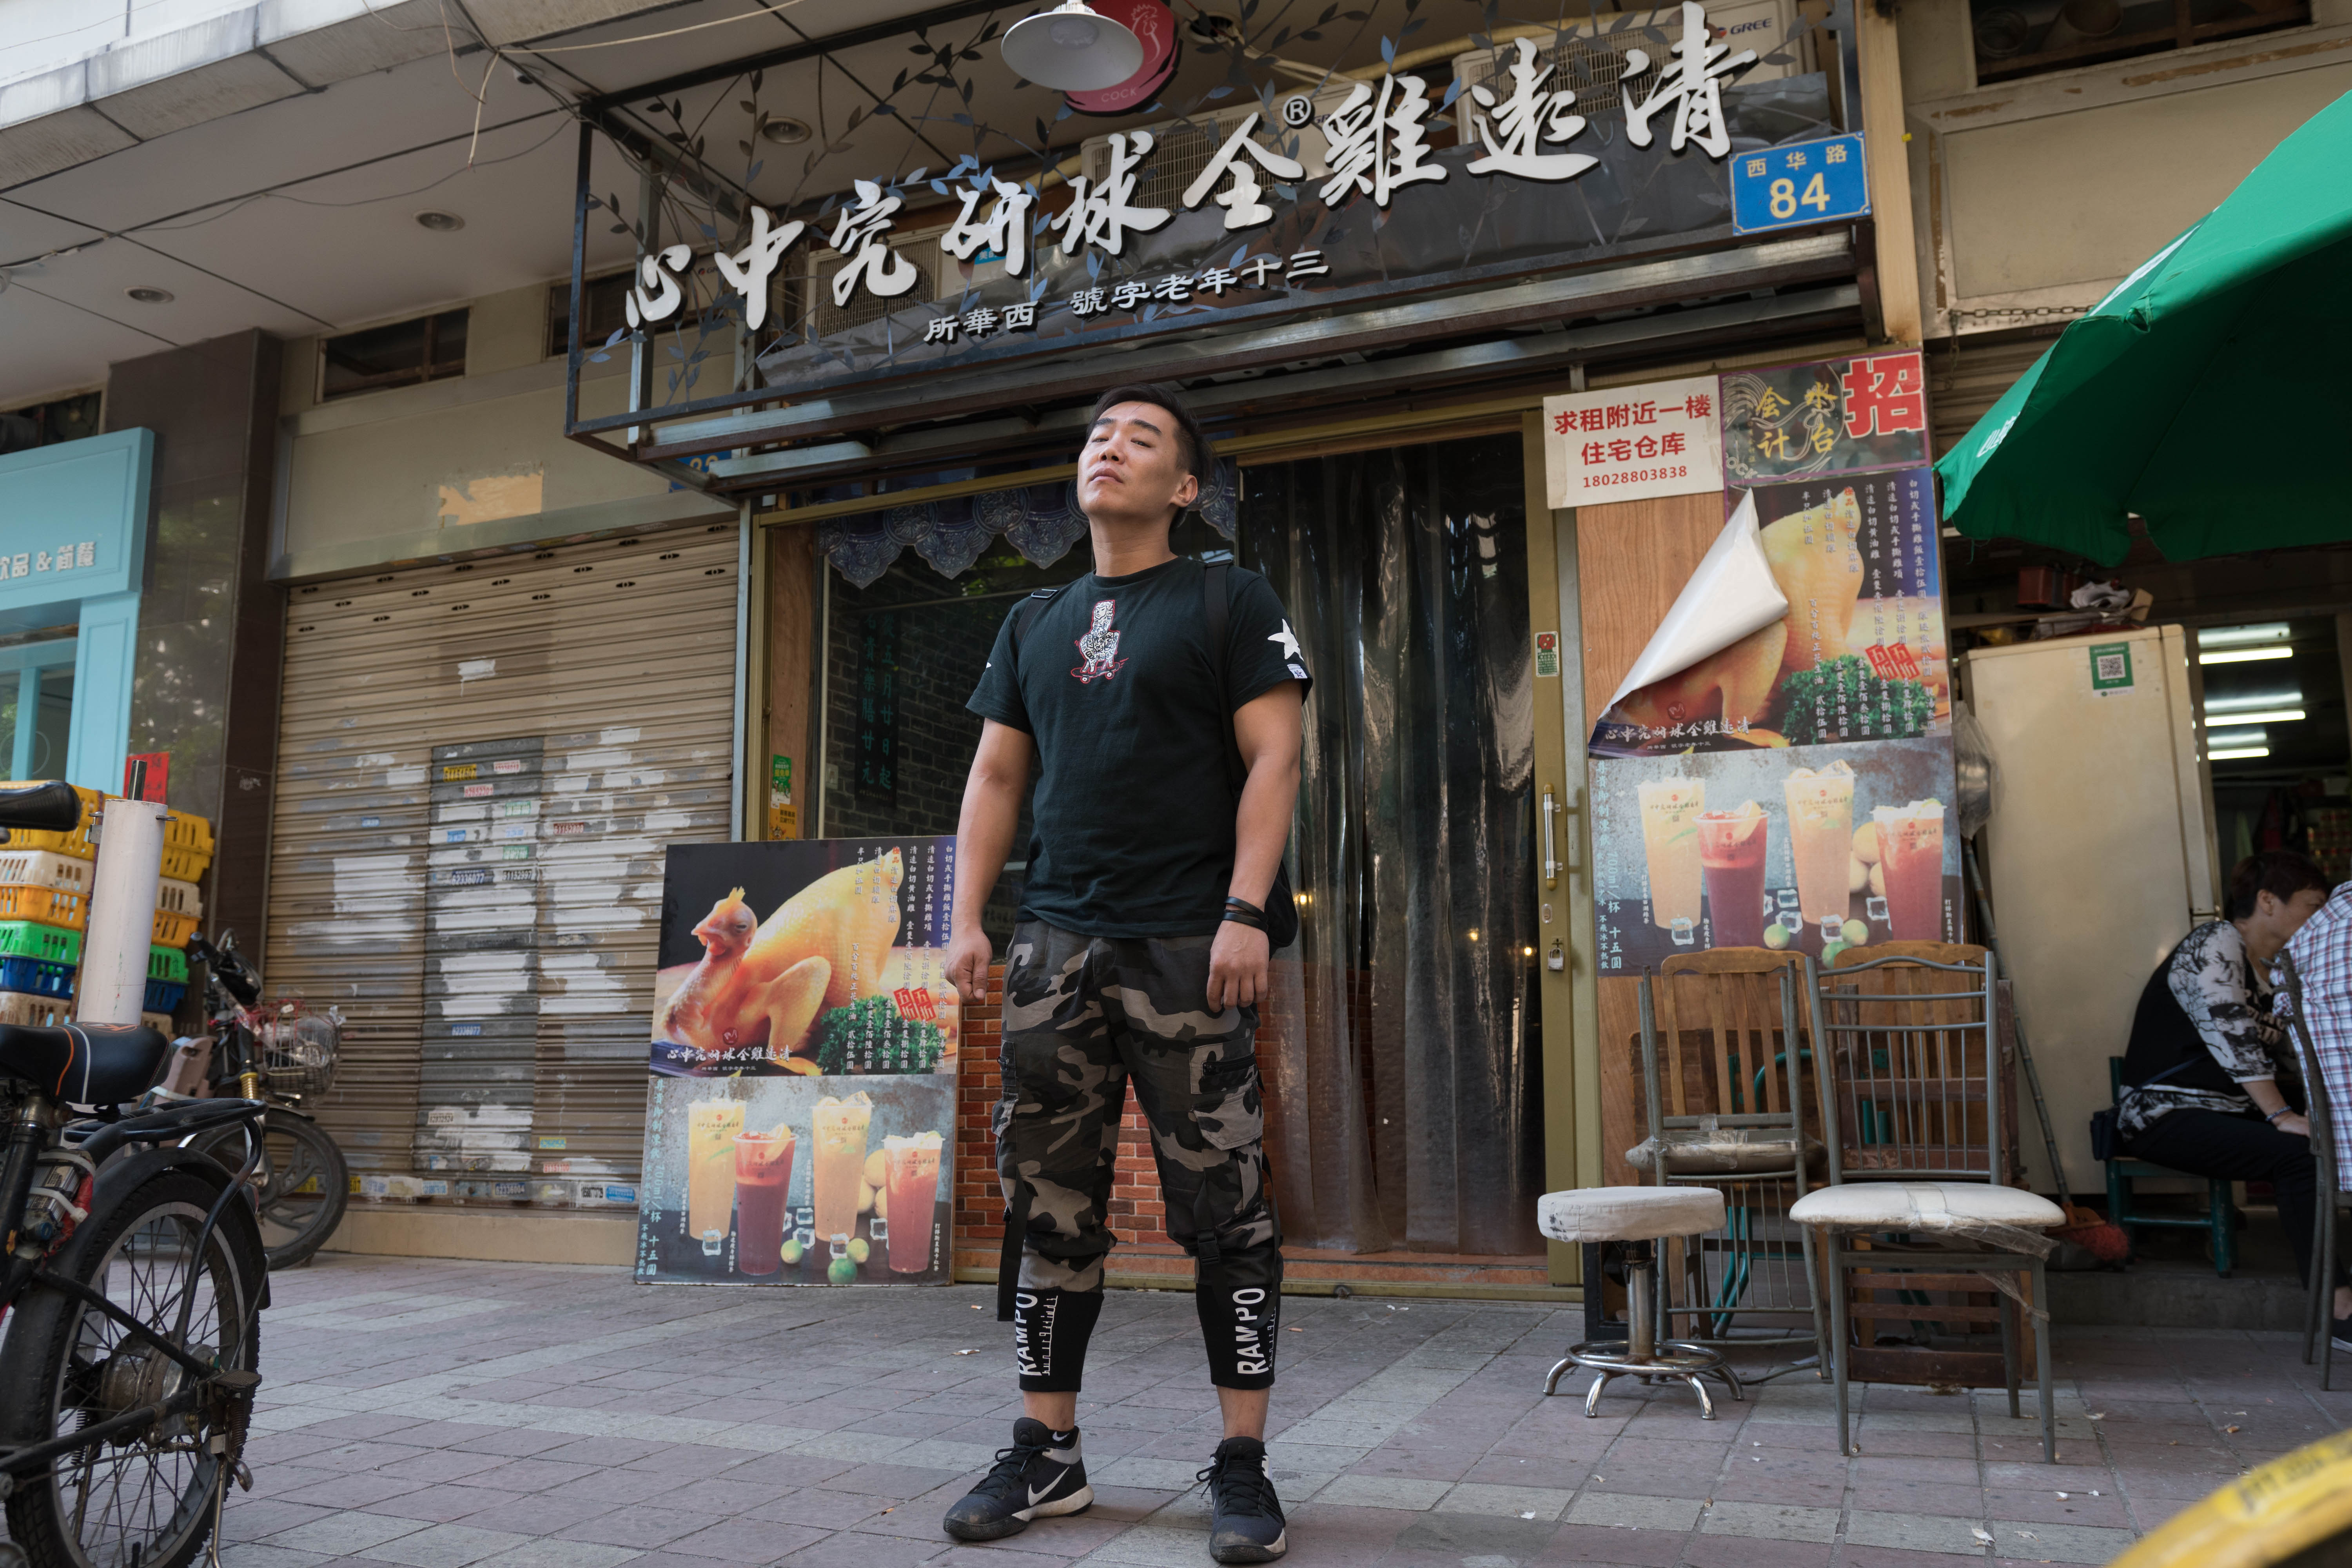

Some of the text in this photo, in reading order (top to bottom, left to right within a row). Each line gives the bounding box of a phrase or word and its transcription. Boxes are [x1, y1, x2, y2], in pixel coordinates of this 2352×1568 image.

[1731, 17, 1772, 35] GREE
[1101, 89, 1137, 102] COCK
[1746, 144, 1847, 178] 西华路
[1770, 172, 1830, 219] 84
[924, 251, 1329, 343] 三十年老字號 西華所
[1554, 394, 1711, 435] 求租附近一楼
[1843, 352, 1925, 439] 招
[1581, 432, 1686, 466] 住宅仓库
[1583, 466, 1687, 488] 18028803838
[36, 551, 53, 572] &
[1609, 927, 1622, 969] 十五圓
[646, 1236, 659, 1276] 十五圓
[1016, 1292, 1042, 1376] RAMPO
[1233, 1287, 1269, 1374] RAMPO
